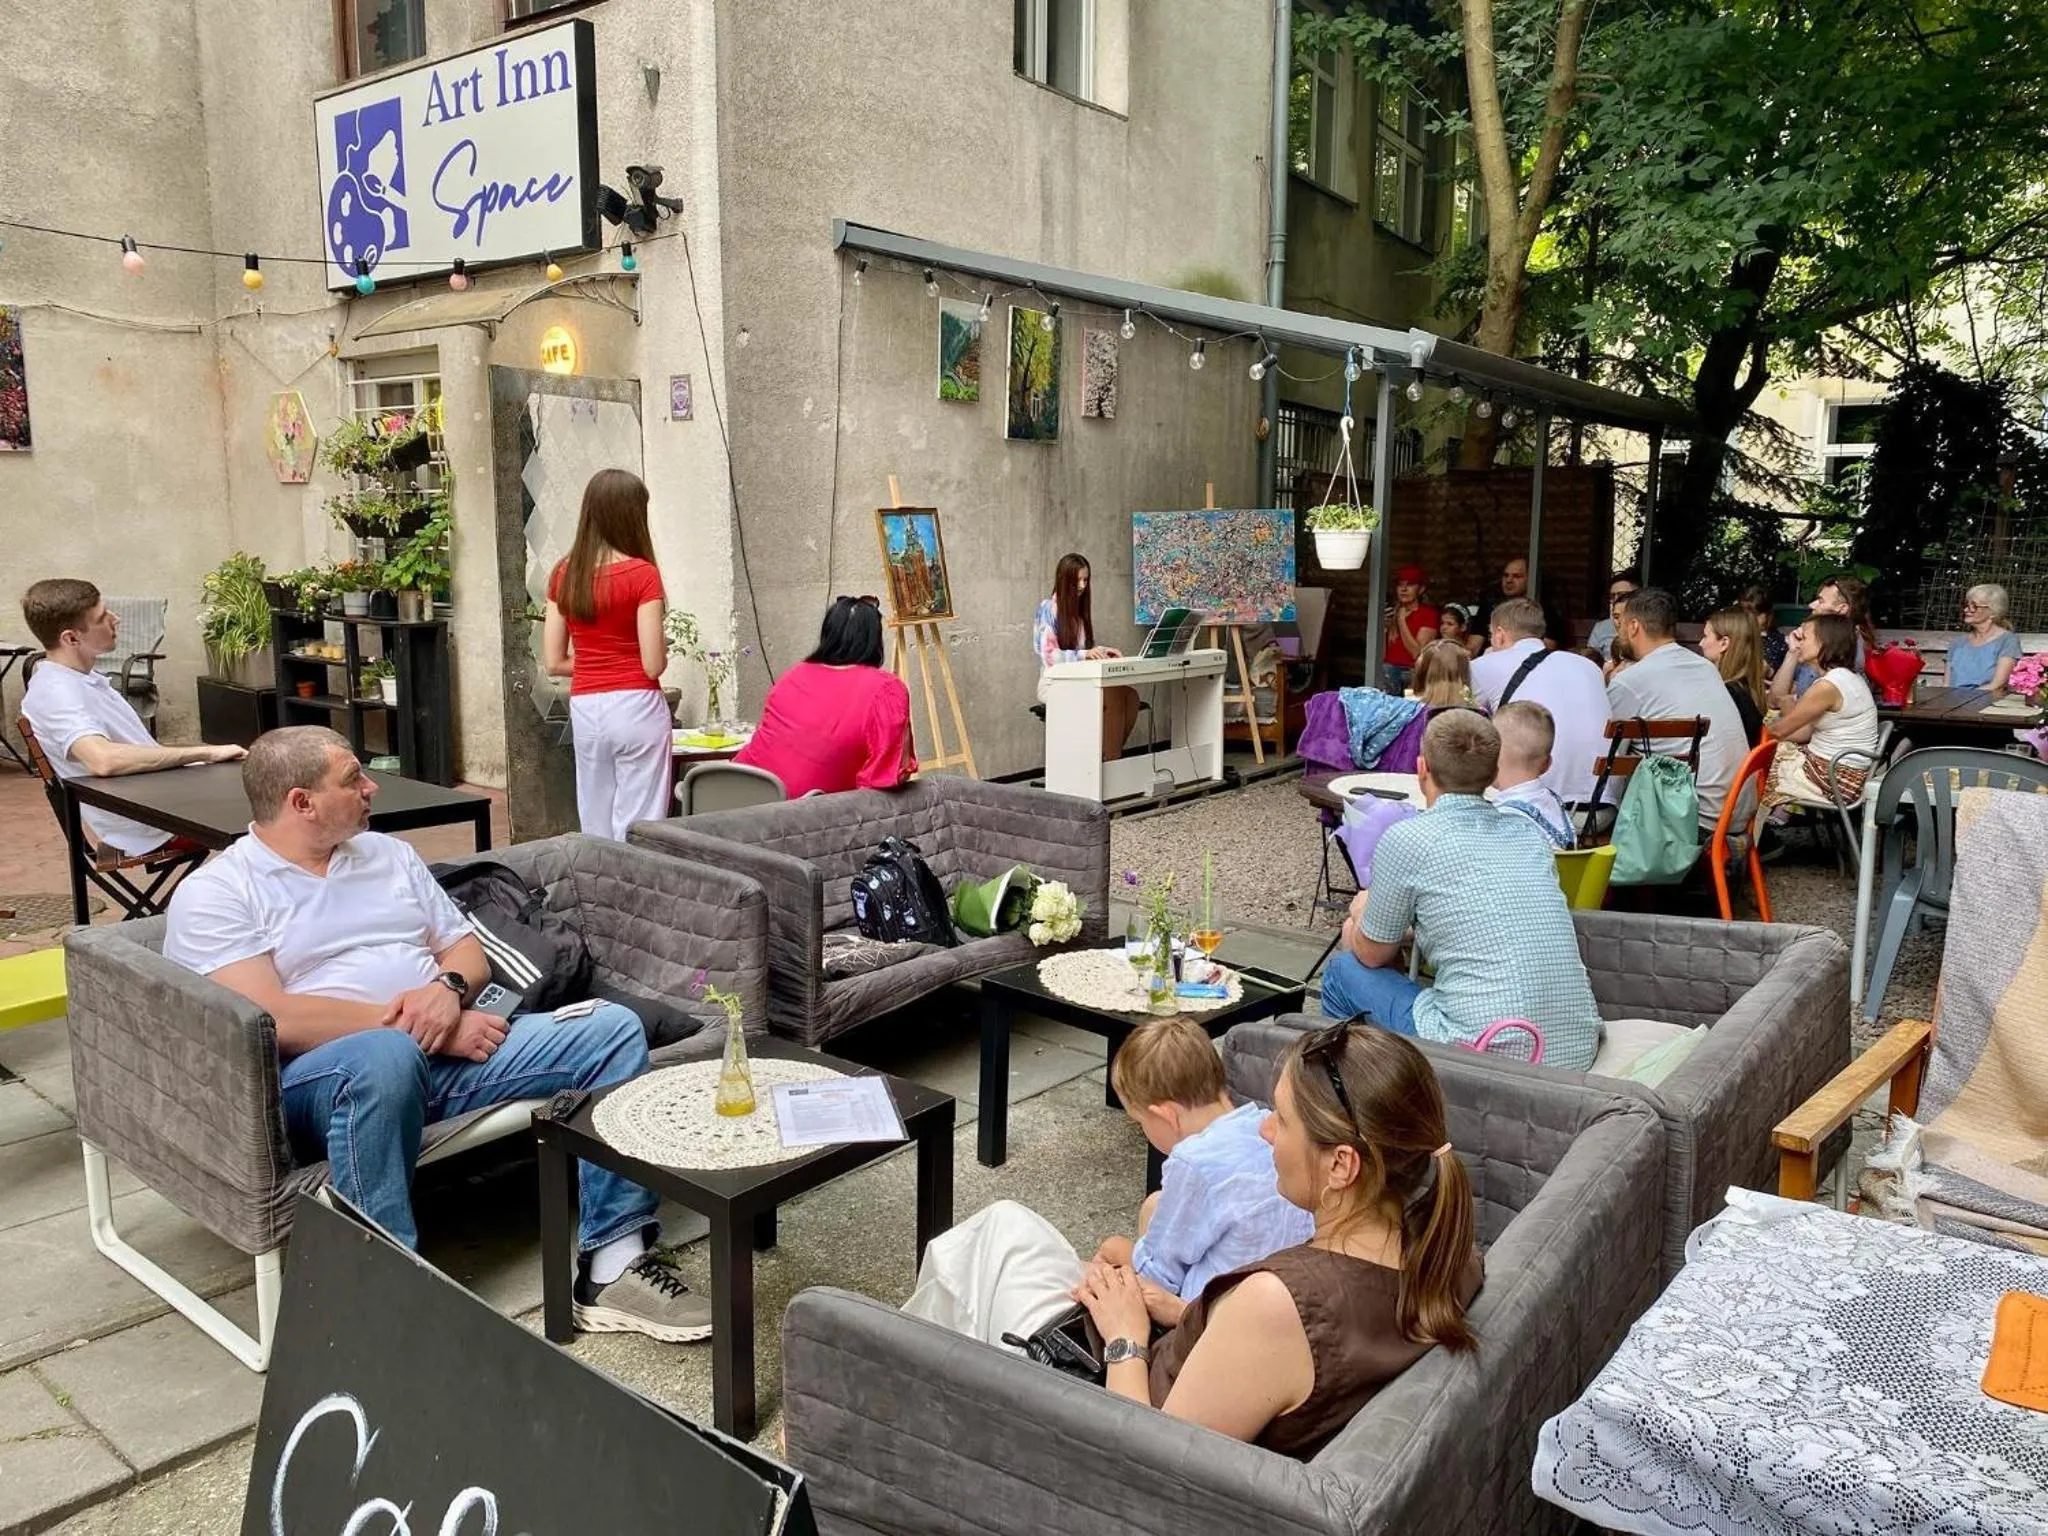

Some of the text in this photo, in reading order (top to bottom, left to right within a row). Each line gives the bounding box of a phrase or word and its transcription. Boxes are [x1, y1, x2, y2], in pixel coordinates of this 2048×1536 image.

[422, 49, 572, 127] Art Inn
[433, 139, 573, 247] Space
